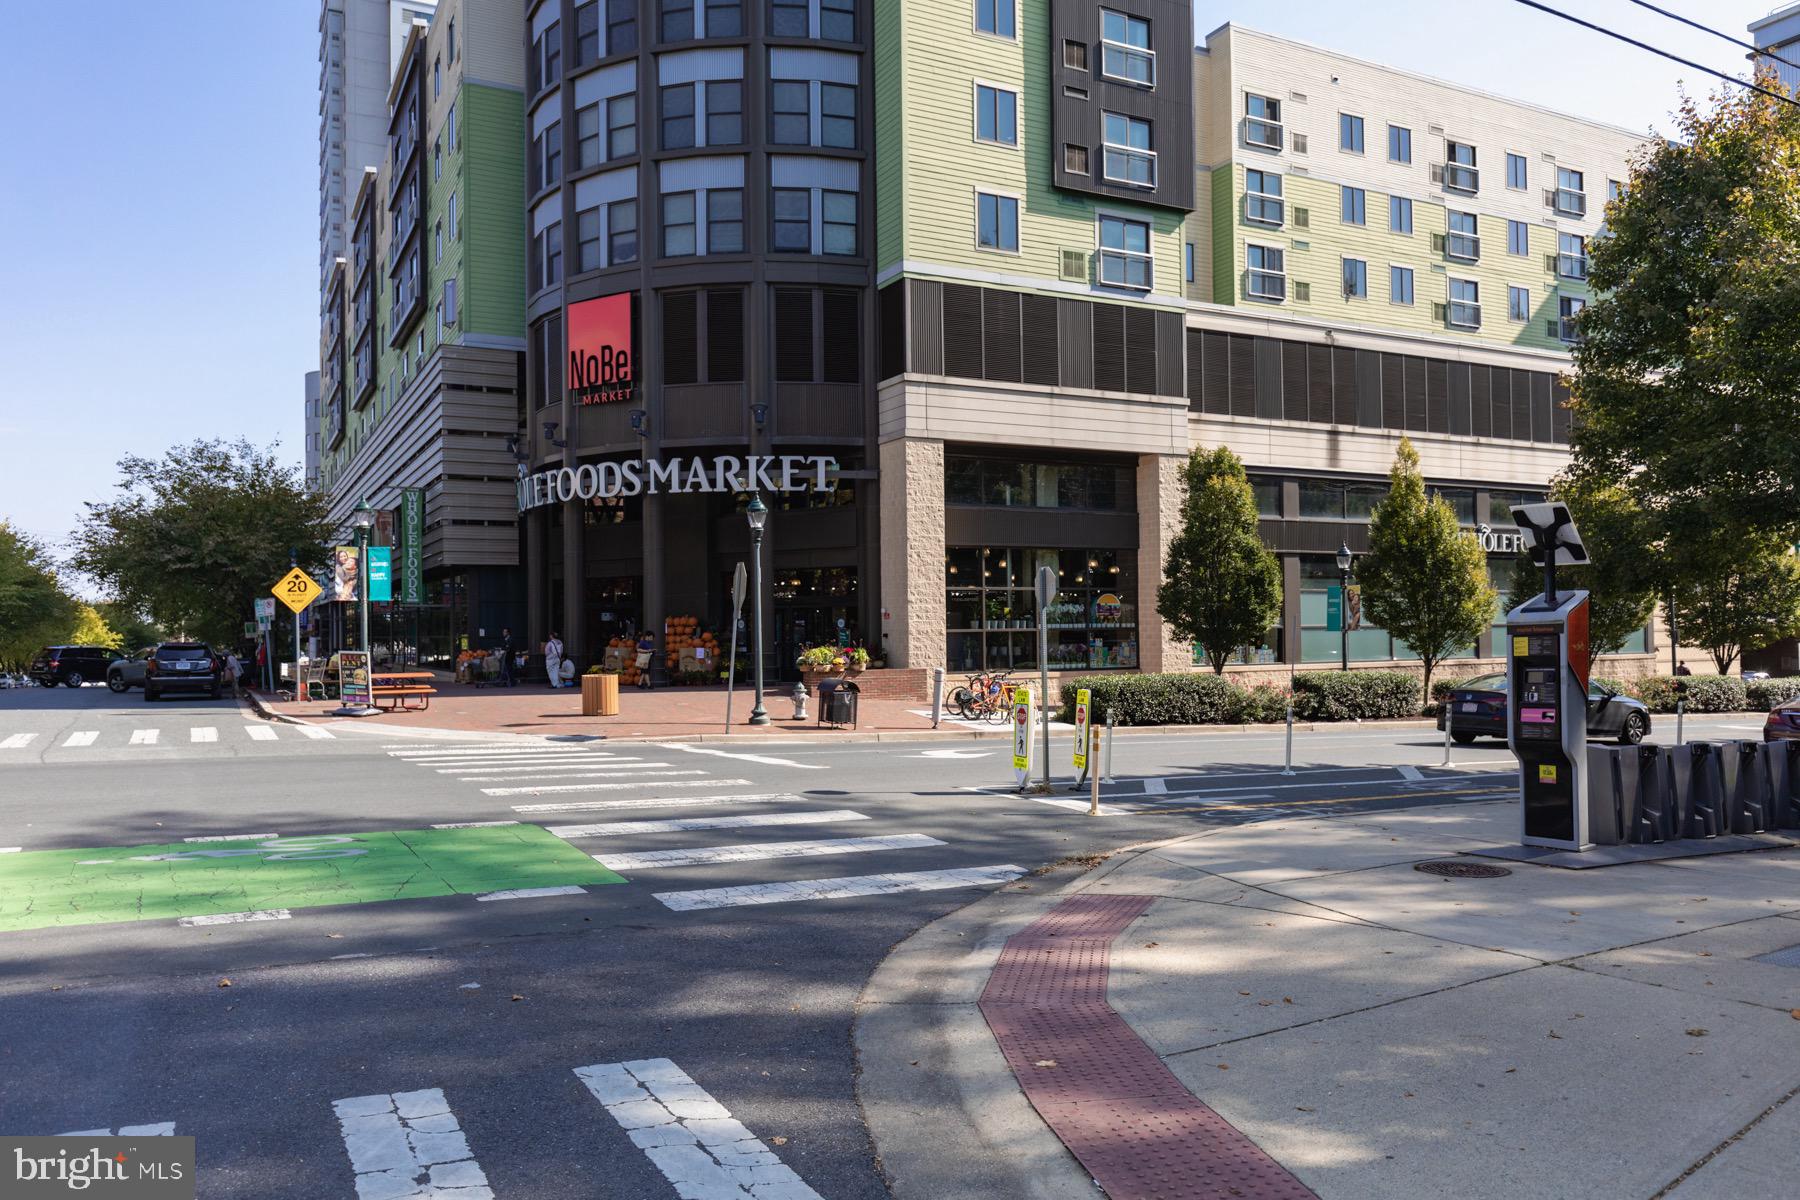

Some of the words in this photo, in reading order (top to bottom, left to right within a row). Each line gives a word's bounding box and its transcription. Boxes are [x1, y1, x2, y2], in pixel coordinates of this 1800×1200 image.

[570, 345, 629, 390] NoBe
[583, 389, 632, 406] MARKET
[545, 459, 643, 503] FOODS
[646, 455, 836, 495] MARKET
[407, 491, 419, 545] WHOLE
[287, 580, 308, 593] 20
[408, 548, 418, 598] FOODS
[1017, 712, 1027, 720] STOP
